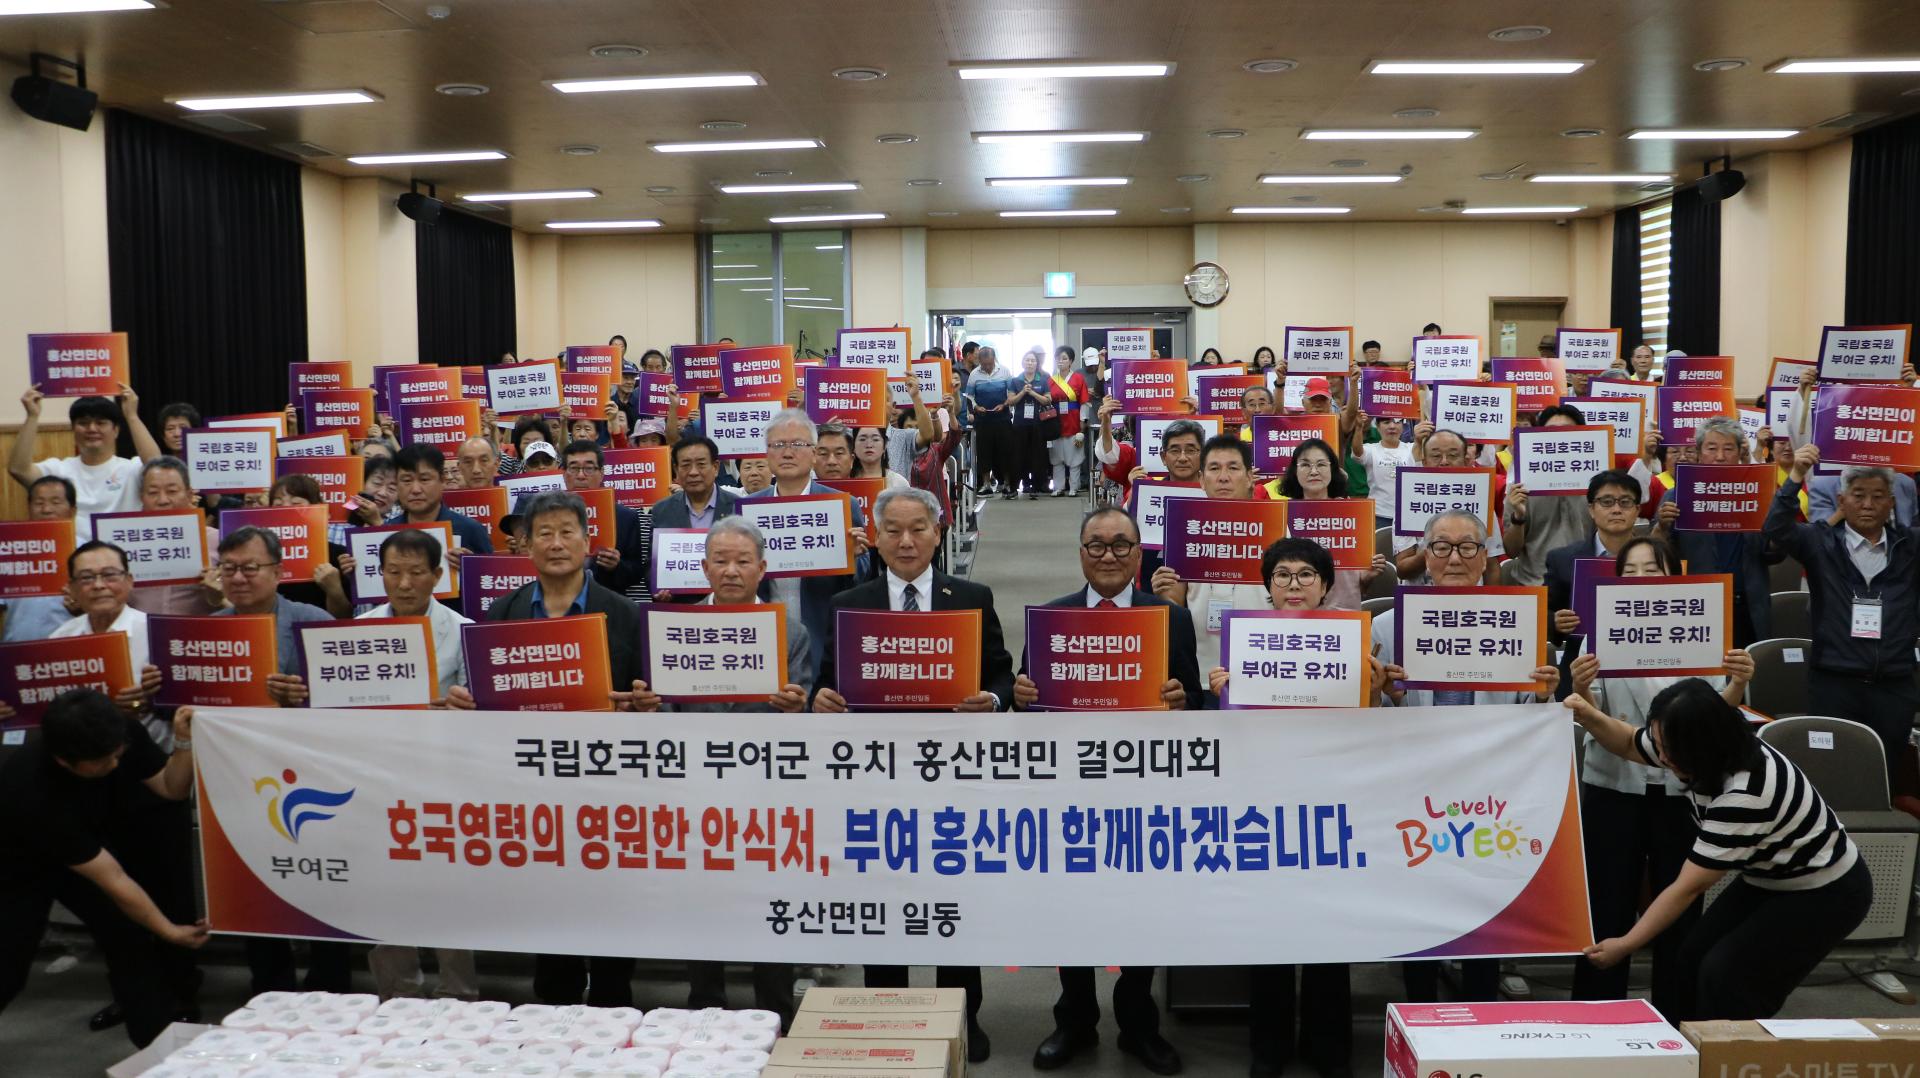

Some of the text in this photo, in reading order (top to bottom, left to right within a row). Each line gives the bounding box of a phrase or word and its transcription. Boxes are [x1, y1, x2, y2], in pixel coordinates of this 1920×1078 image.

[850, 340, 896, 350] 국립호국원
[1296, 338, 1340, 347] 국립호국원
[1568, 338, 1608, 347] 국립호국원
[1838, 339, 1894, 350] 국립호국원
[1294, 351, 1342, 360] 부여군 유치!
[1425, 346, 1468, 354] 국립호국원
[1565, 350, 1611, 359] 부여군 유치!
[684, 356, 720, 366] 홍산면민
[733, 358, 780, 372] 홍산면민이
[846, 354, 899, 364] 부여군 유치!
[1422, 358, 1471, 368] 부여군 유치!
[1831, 354, 1895, 365] 부여군 유치!
[499, 372, 546, 385] 국립호국원
[685, 370, 720, 380] 함께합니
[734, 374, 782, 386] 함께합니다
[1125, 373, 1174, 384] 홍산면민이
[1505, 371, 1552, 381] 홍산면민이
[1678, 370, 1722, 380] 홍산면민이
[497, 386, 551, 399] 부여군 유치!
[562, 384, 598, 394] 산면민이
[819, 382, 870, 394] 홍산면민이
[1126, 388, 1174, 398] 함께합니다
[1211, 388, 1245, 397] 홍산면민
[1516, 384, 1554, 395] 께합니다
[564, 397, 598, 406] 께합니다
[819, 398, 871, 410] 함께합니다
[1449, 394, 1500, 407] 국립호국원
[1672, 401, 1722, 412] 홍산면민이
[716, 411, 770, 422] 국립호국원
[1444, 411, 1502, 424] 부여군 유치!
[1836, 404, 1914, 423] 홍산면민이
[316, 416, 360, 426] 함께합니다
[412, 415, 464, 428] 홍산면민이
[413, 431, 466, 444] 함께합니다
[714, 428, 746, 440] 부여군
[1268, 430, 1322, 441] 홍산면민이
[1834, 426, 1914, 444] 함께합니다
[199, 442, 258, 454] 국립호국원
[1532, 441, 1594, 454] 국립호국원
[196, 460, 262, 473] 부여군 유치!
[603, 463, 655, 474] 홍산면민이
[1528, 460, 1599, 474] 부여군 유치!
[603, 478, 656, 491] 함께합니다
[1414, 483, 1476, 496] 국립호국원
[1693, 482, 1759, 495] 홍산면민이
[1410, 502, 1446, 514] 부여군
[1692, 500, 1758, 513] 함께합니다
[757, 512, 829, 529] 국립호국원
[1293, 517, 1356, 530] 홍산면민이
[113, 527, 184, 542] 국립호국원
[1186, 520, 1263, 537] 홍산면민이
[0, 540, 56, 554] 산면민이
[802, 534, 835, 549] 유치!
[128, 546, 190, 562] 여군 유치!
[1185, 542, 1264, 560] 함께합니다
[0, 560, 58, 575] 께합니다
[1615, 599, 1705, 617] 국립호국원
[1422, 610, 1516, 628] 국립호국원
[666, 627, 757, 645] 국립호국원
[1609, 626, 1710, 644] 부여군 유치!
[169, 640, 250, 657] 홍산면민이
[322, 638, 407, 656] 국립호국원
[862, 636, 953, 654] 홍산면민이
[1050, 634, 1141, 654] 홍산면민이
[1248, 633, 1341, 652] 국립호국원
[1416, 638, 1522, 656] 부여군 유치!
[490, 643, 581, 666] 홍산면민이
[662, 654, 764, 671] 부여군 유치!
[15, 658, 105, 681] 홍산면민이
[170, 665, 252, 682] 함께합니다
[320, 664, 416, 682] 부여군 유치!
[862, 663, 954, 681] 함께합니다
[1050, 662, 1142, 681] 함께합니다
[1242, 661, 1347, 680] 부여군 유치!
[492, 668, 584, 692] 함께합니다
[1072, 697, 1091, 705] 홍산면
[515, 738, 1221, 782] 국립호국원 부여군 유치 홍산면민 결의대회
[1424, 795, 1507, 820] Lovely
[387, 800, 1366, 876] 호국영령의 영원한 안식처, 부여 홍산이 함께하겠습니다.
[272, 856, 350, 882] 부여군
[766, 899, 962, 937] 홍산면민 일동
